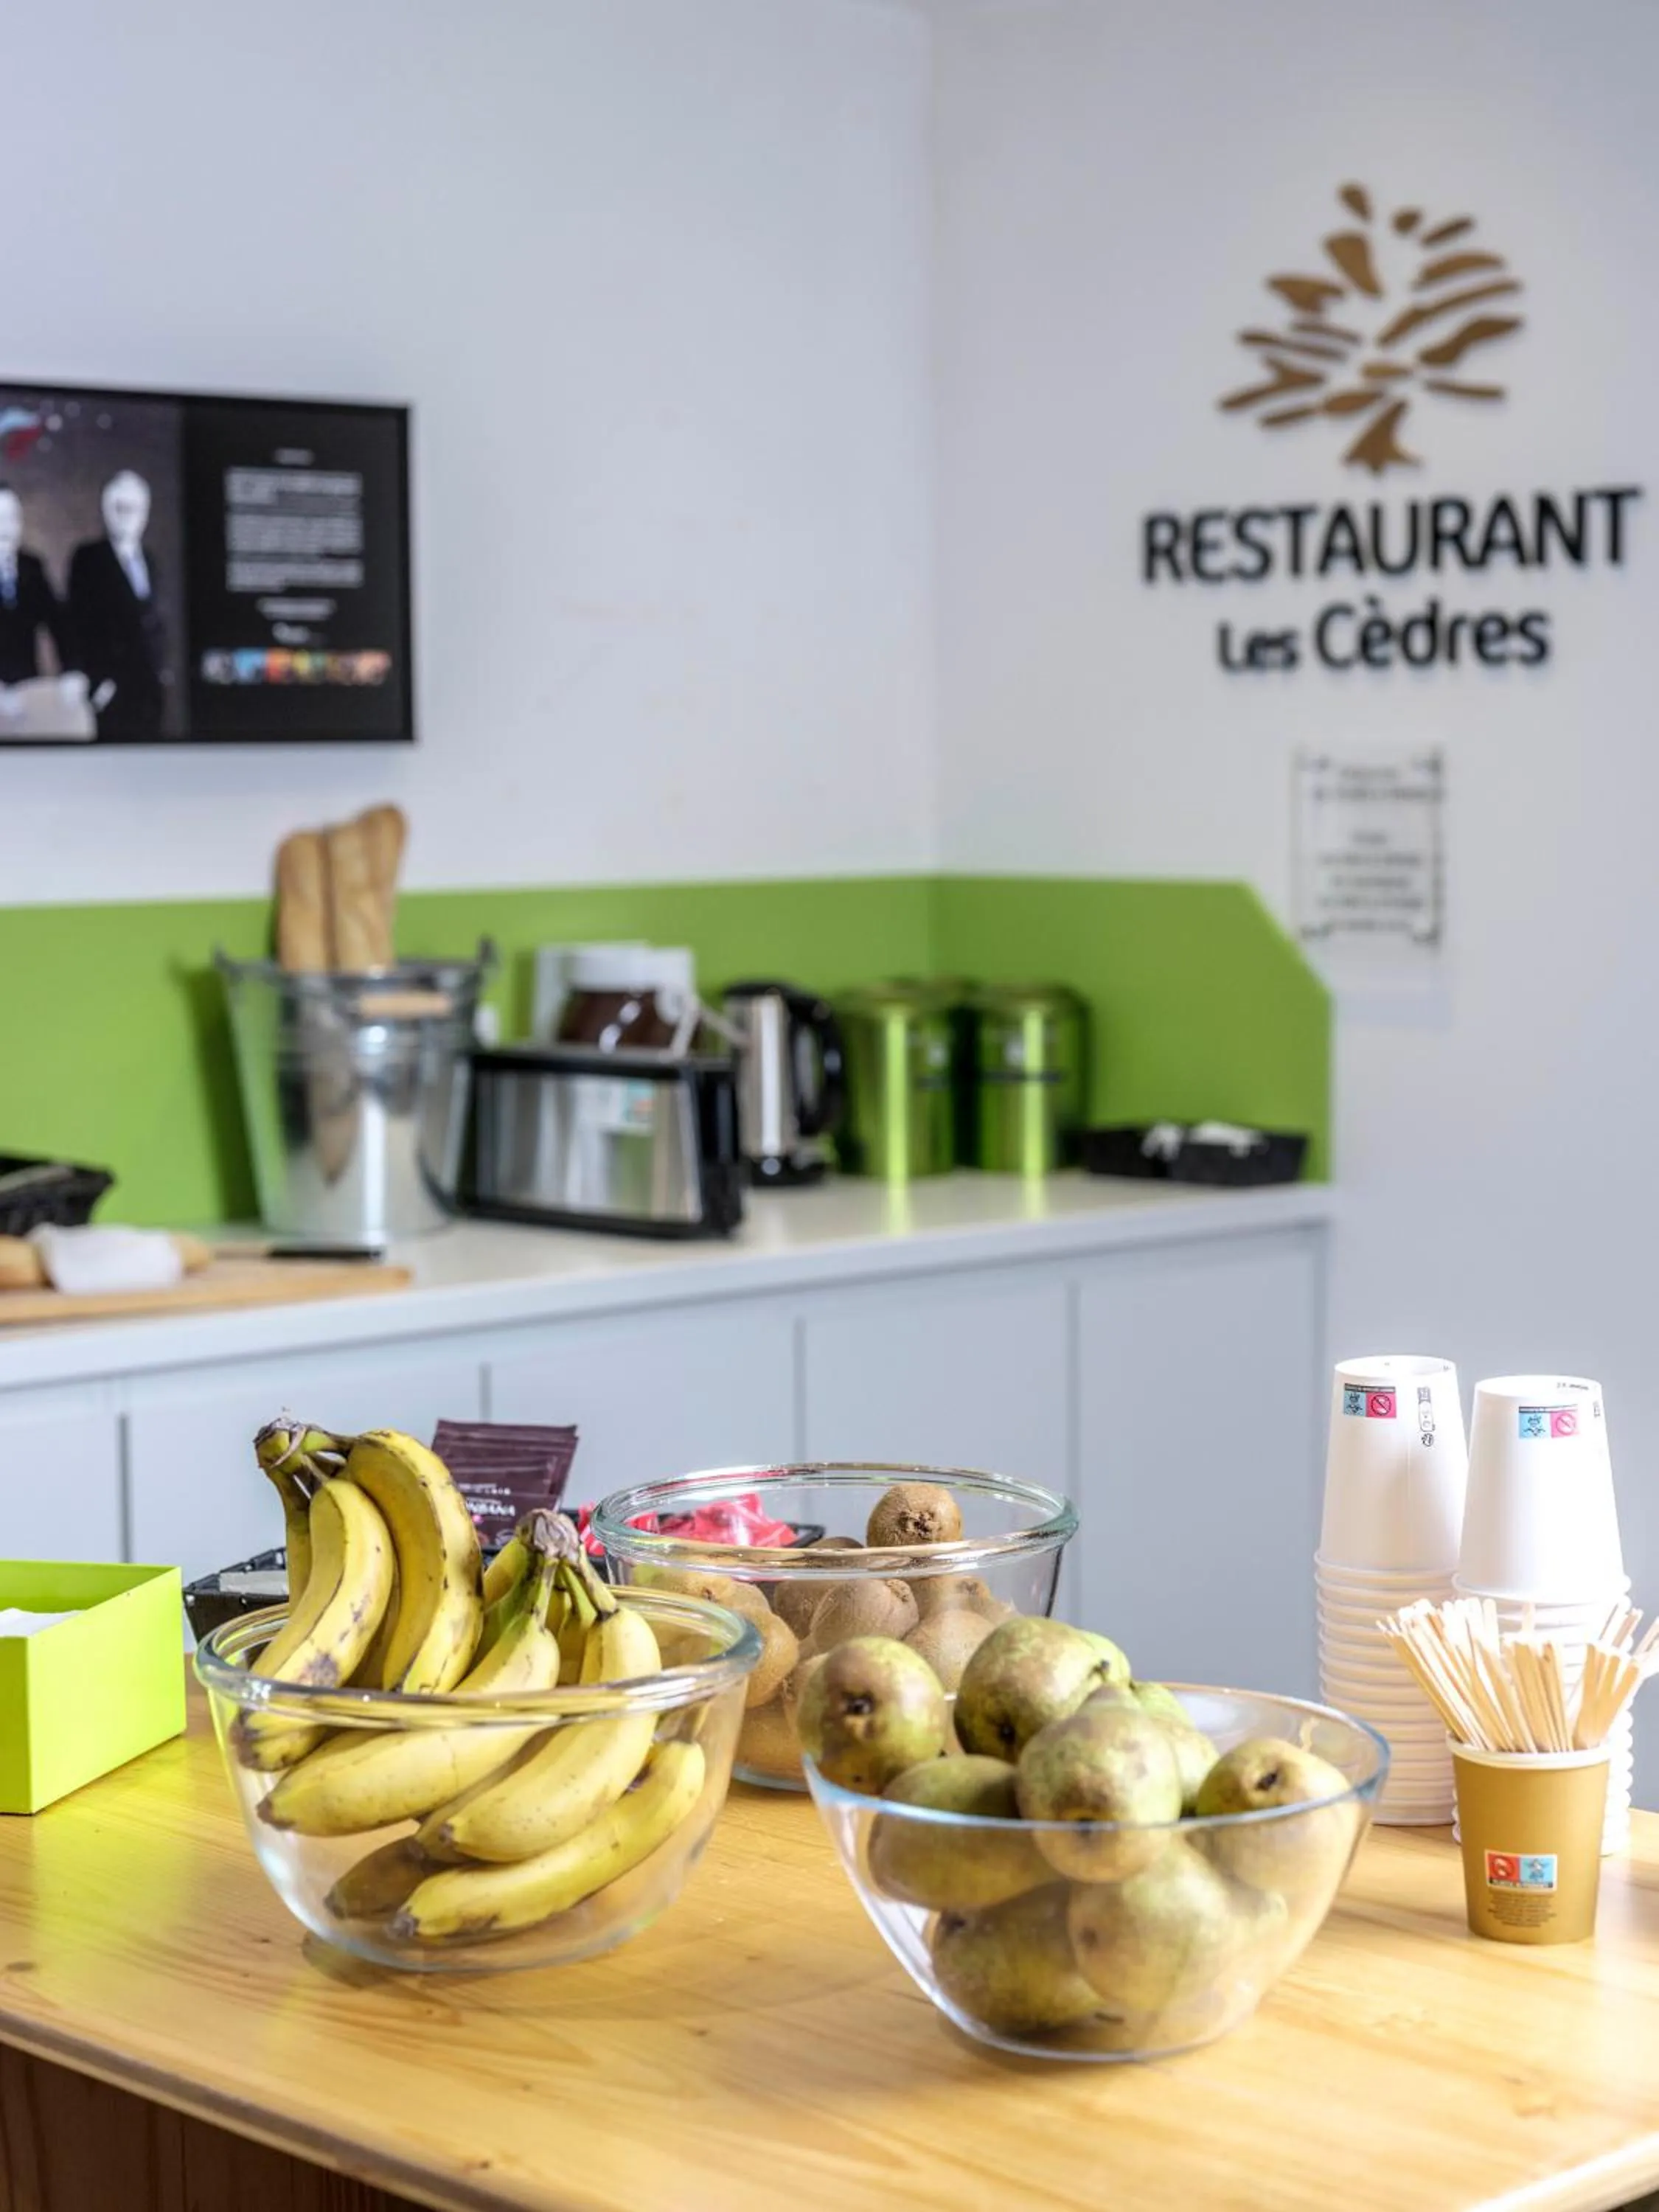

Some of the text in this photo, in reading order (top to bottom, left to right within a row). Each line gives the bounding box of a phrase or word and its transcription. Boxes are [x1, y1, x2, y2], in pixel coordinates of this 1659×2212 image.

[1144, 487, 1641, 583] RESTAURANT
[1218, 595, 1549, 672] Les Cèdres
